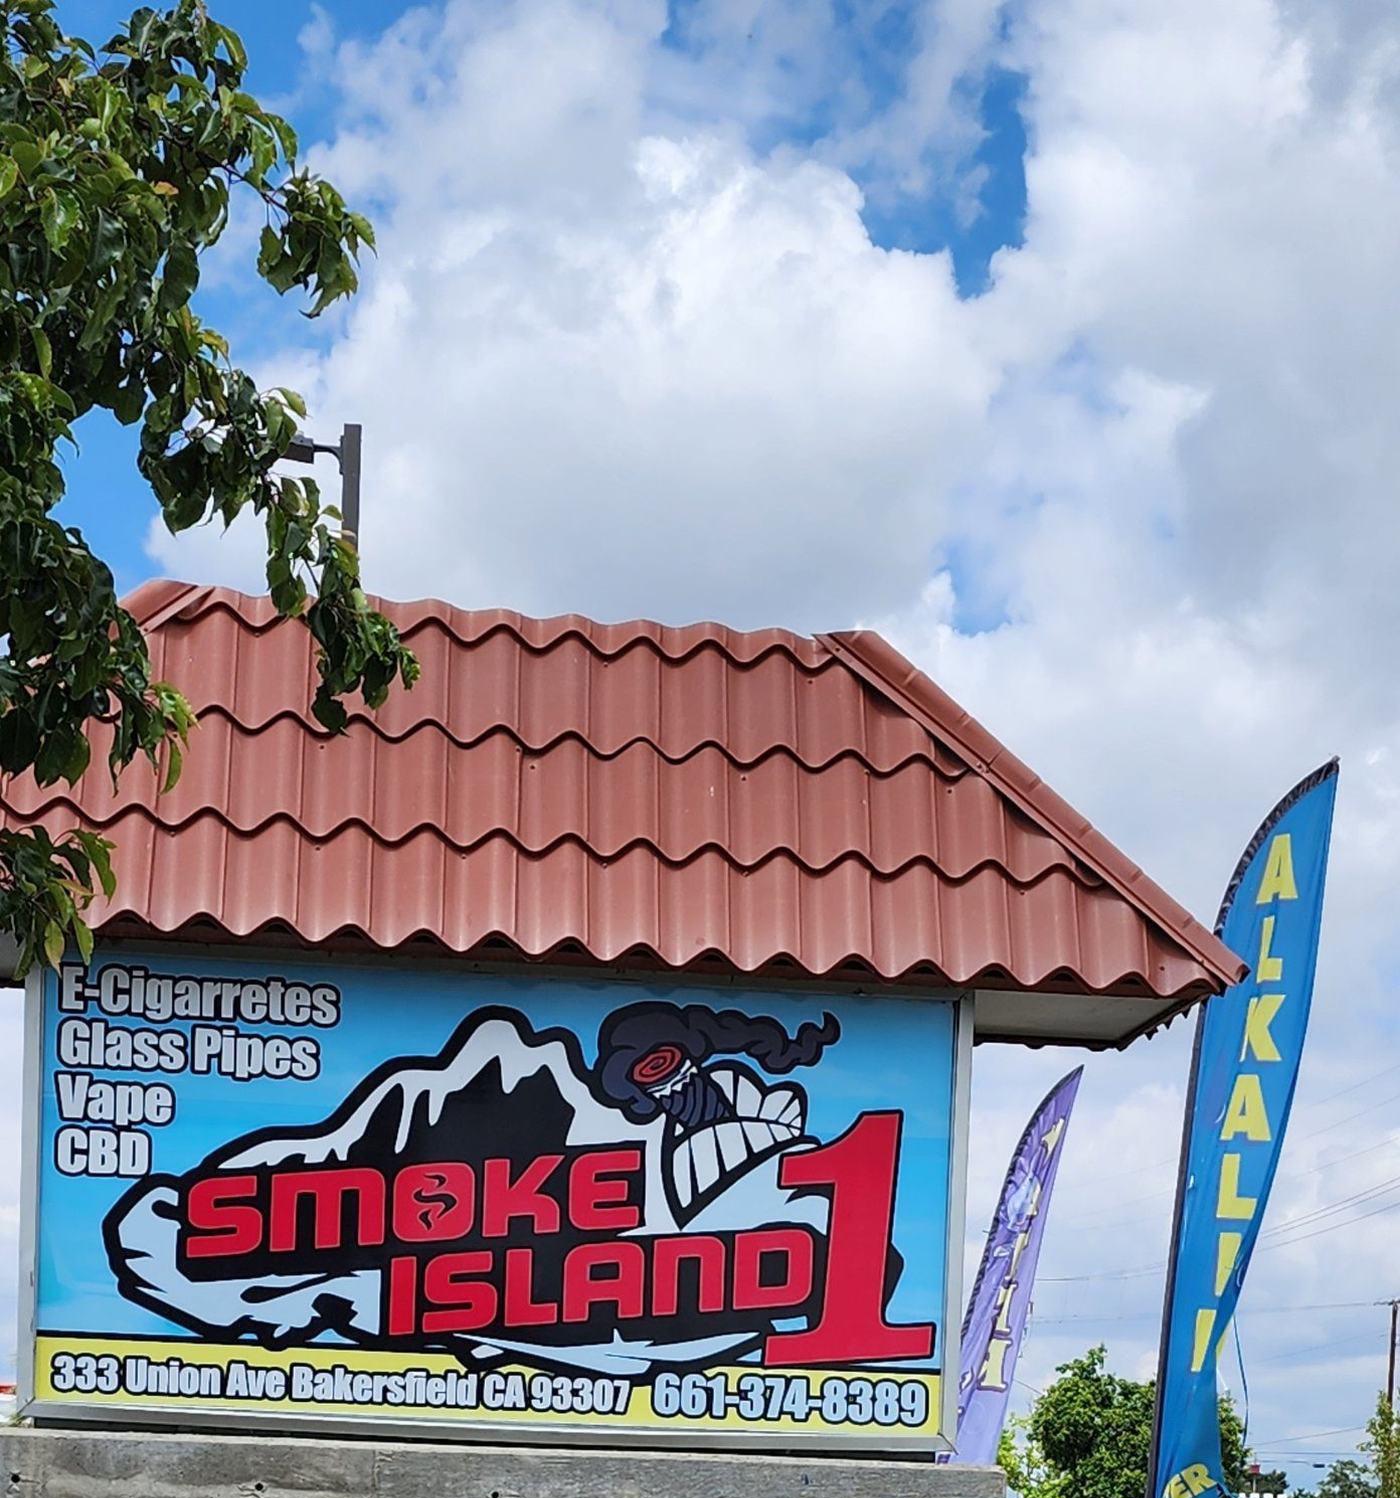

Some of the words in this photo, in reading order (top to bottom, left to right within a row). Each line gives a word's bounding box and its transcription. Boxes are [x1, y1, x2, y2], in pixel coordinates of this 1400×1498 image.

[62, 965, 338, 1025] E-Cigarretes
[59, 1020, 184, 1071] Glass
[195, 1029, 318, 1078] Pipes
[58, 1075, 173, 1127] Vape
[57, 1130, 149, 1176] CBD
[186, 1149, 641, 1258] SMOKE
[388, 1228, 814, 1336] ISLAND
[763, 1112, 934, 1367] 1
[53, 1355, 119, 1392] 333
[125, 1359, 219, 1396] Union
[226, 1363, 284, 1399] Ave
[292, 1366, 478, 1408] Bakersfield
[483, 1374, 523, 1410] CA
[531, 1376, 631, 1414] 93307
[653, 1372, 927, 1426] 661-374-8389
